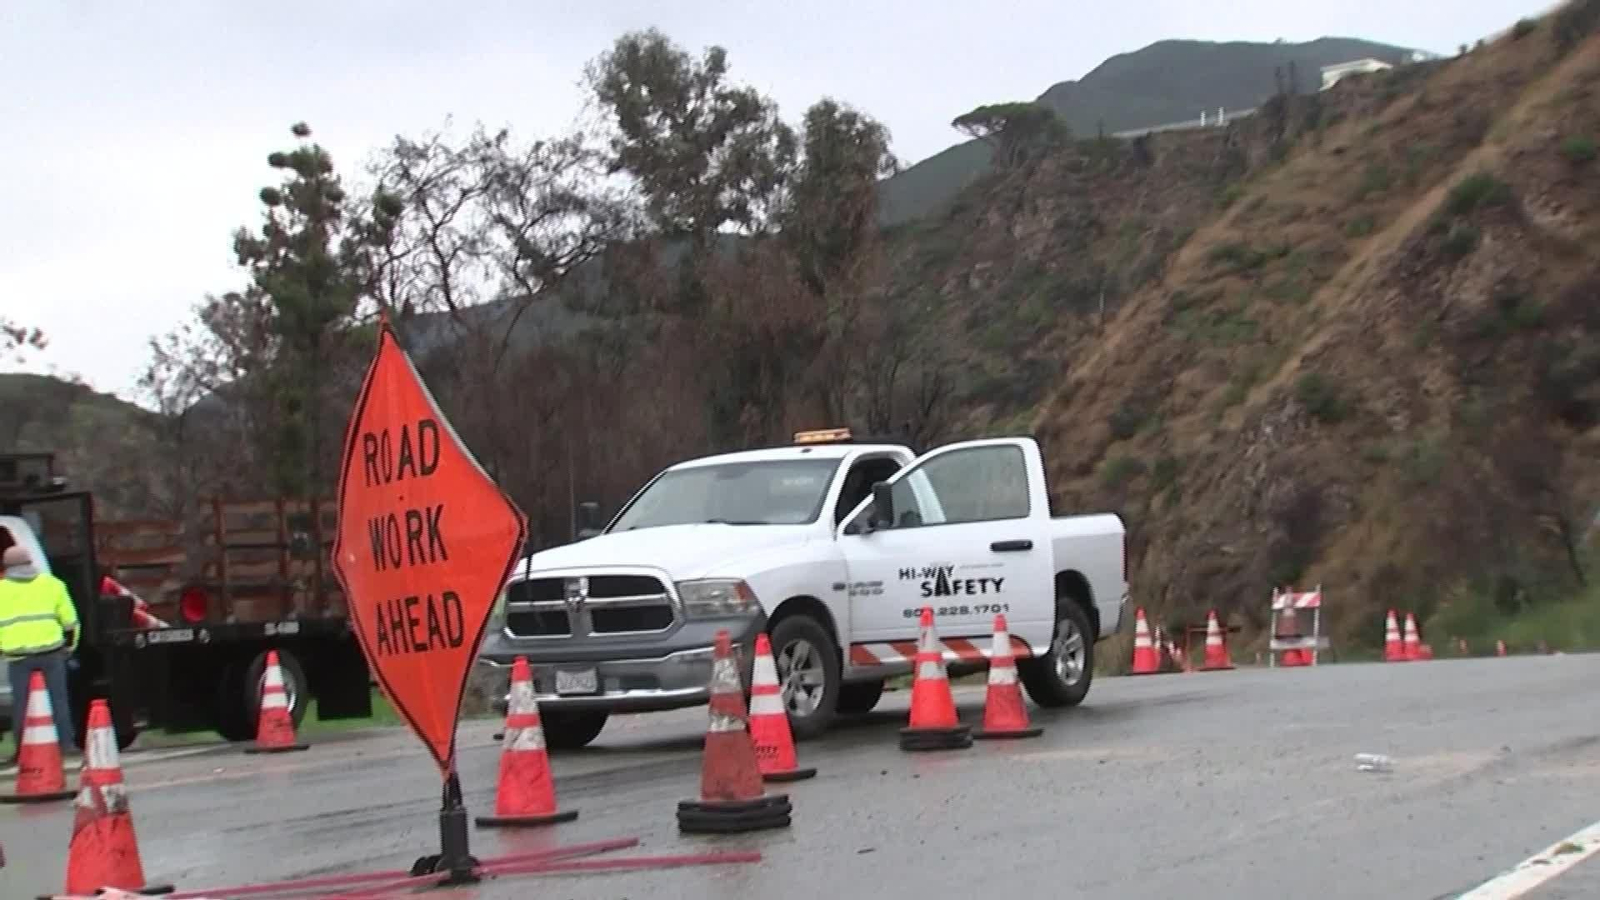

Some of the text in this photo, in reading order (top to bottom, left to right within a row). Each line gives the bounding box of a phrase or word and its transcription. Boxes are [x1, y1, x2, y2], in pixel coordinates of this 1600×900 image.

[363, 419, 440, 487] ROAD
[368, 504, 448, 571] WORK
[899, 566, 954, 580] HI-WAY
[921, 568, 1005, 597] SAFETY
[376, 591, 464, 656] AHEAD
[903, 604, 1009, 618] 80.228.1701
